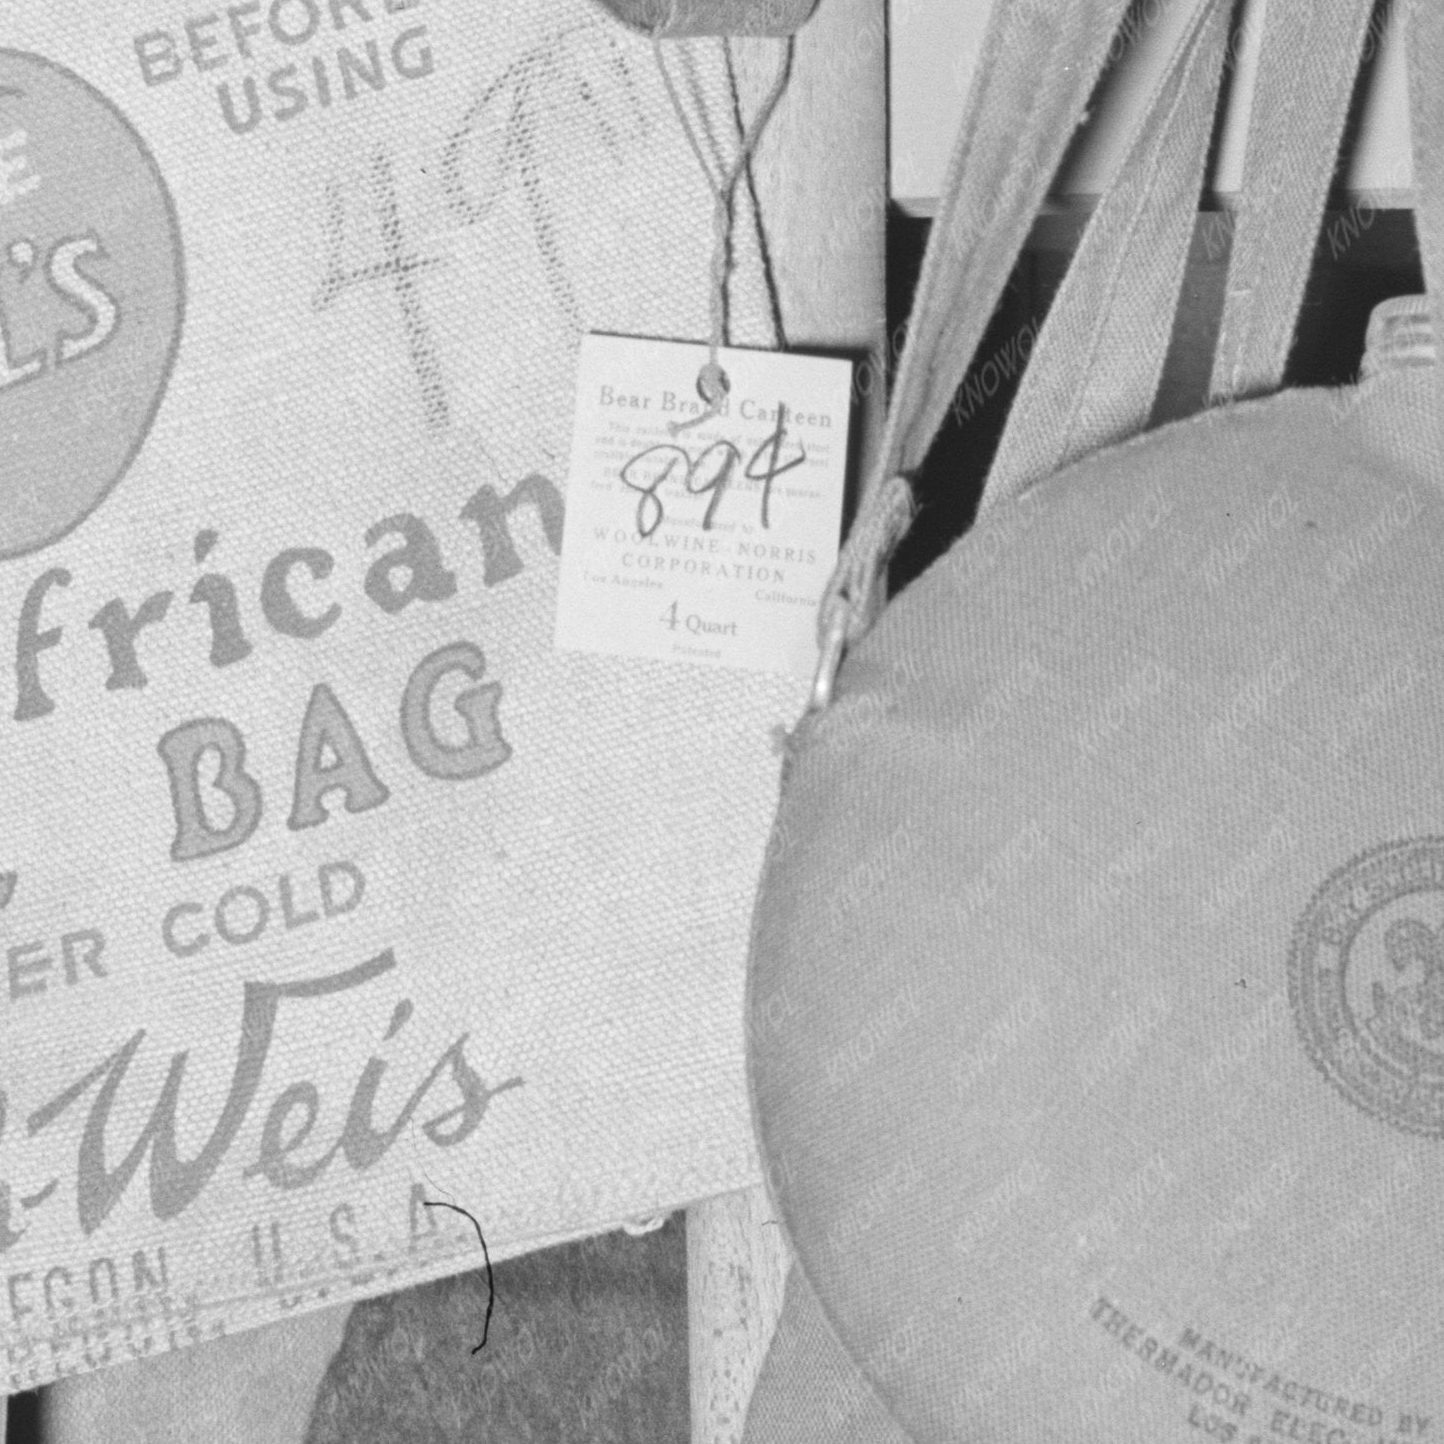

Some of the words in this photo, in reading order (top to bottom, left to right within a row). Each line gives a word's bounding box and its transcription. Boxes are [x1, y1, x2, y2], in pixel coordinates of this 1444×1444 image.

[213, 25, 437, 138] USING
[599, 385, 652, 410] Bear
[621, 552, 787, 584] CORPORATION
[658, 600, 681, 632] 4
[685, 614, 739, 638] Quart
[158, 640, 515, 862] BAG
[159, 858, 369, 960] COLD
[1090, 1296, 1255, 1419] THERMADOR
[1186, 1402, 1241, 1444] LOS
[1395, 1413, 1432, 1437] BY
